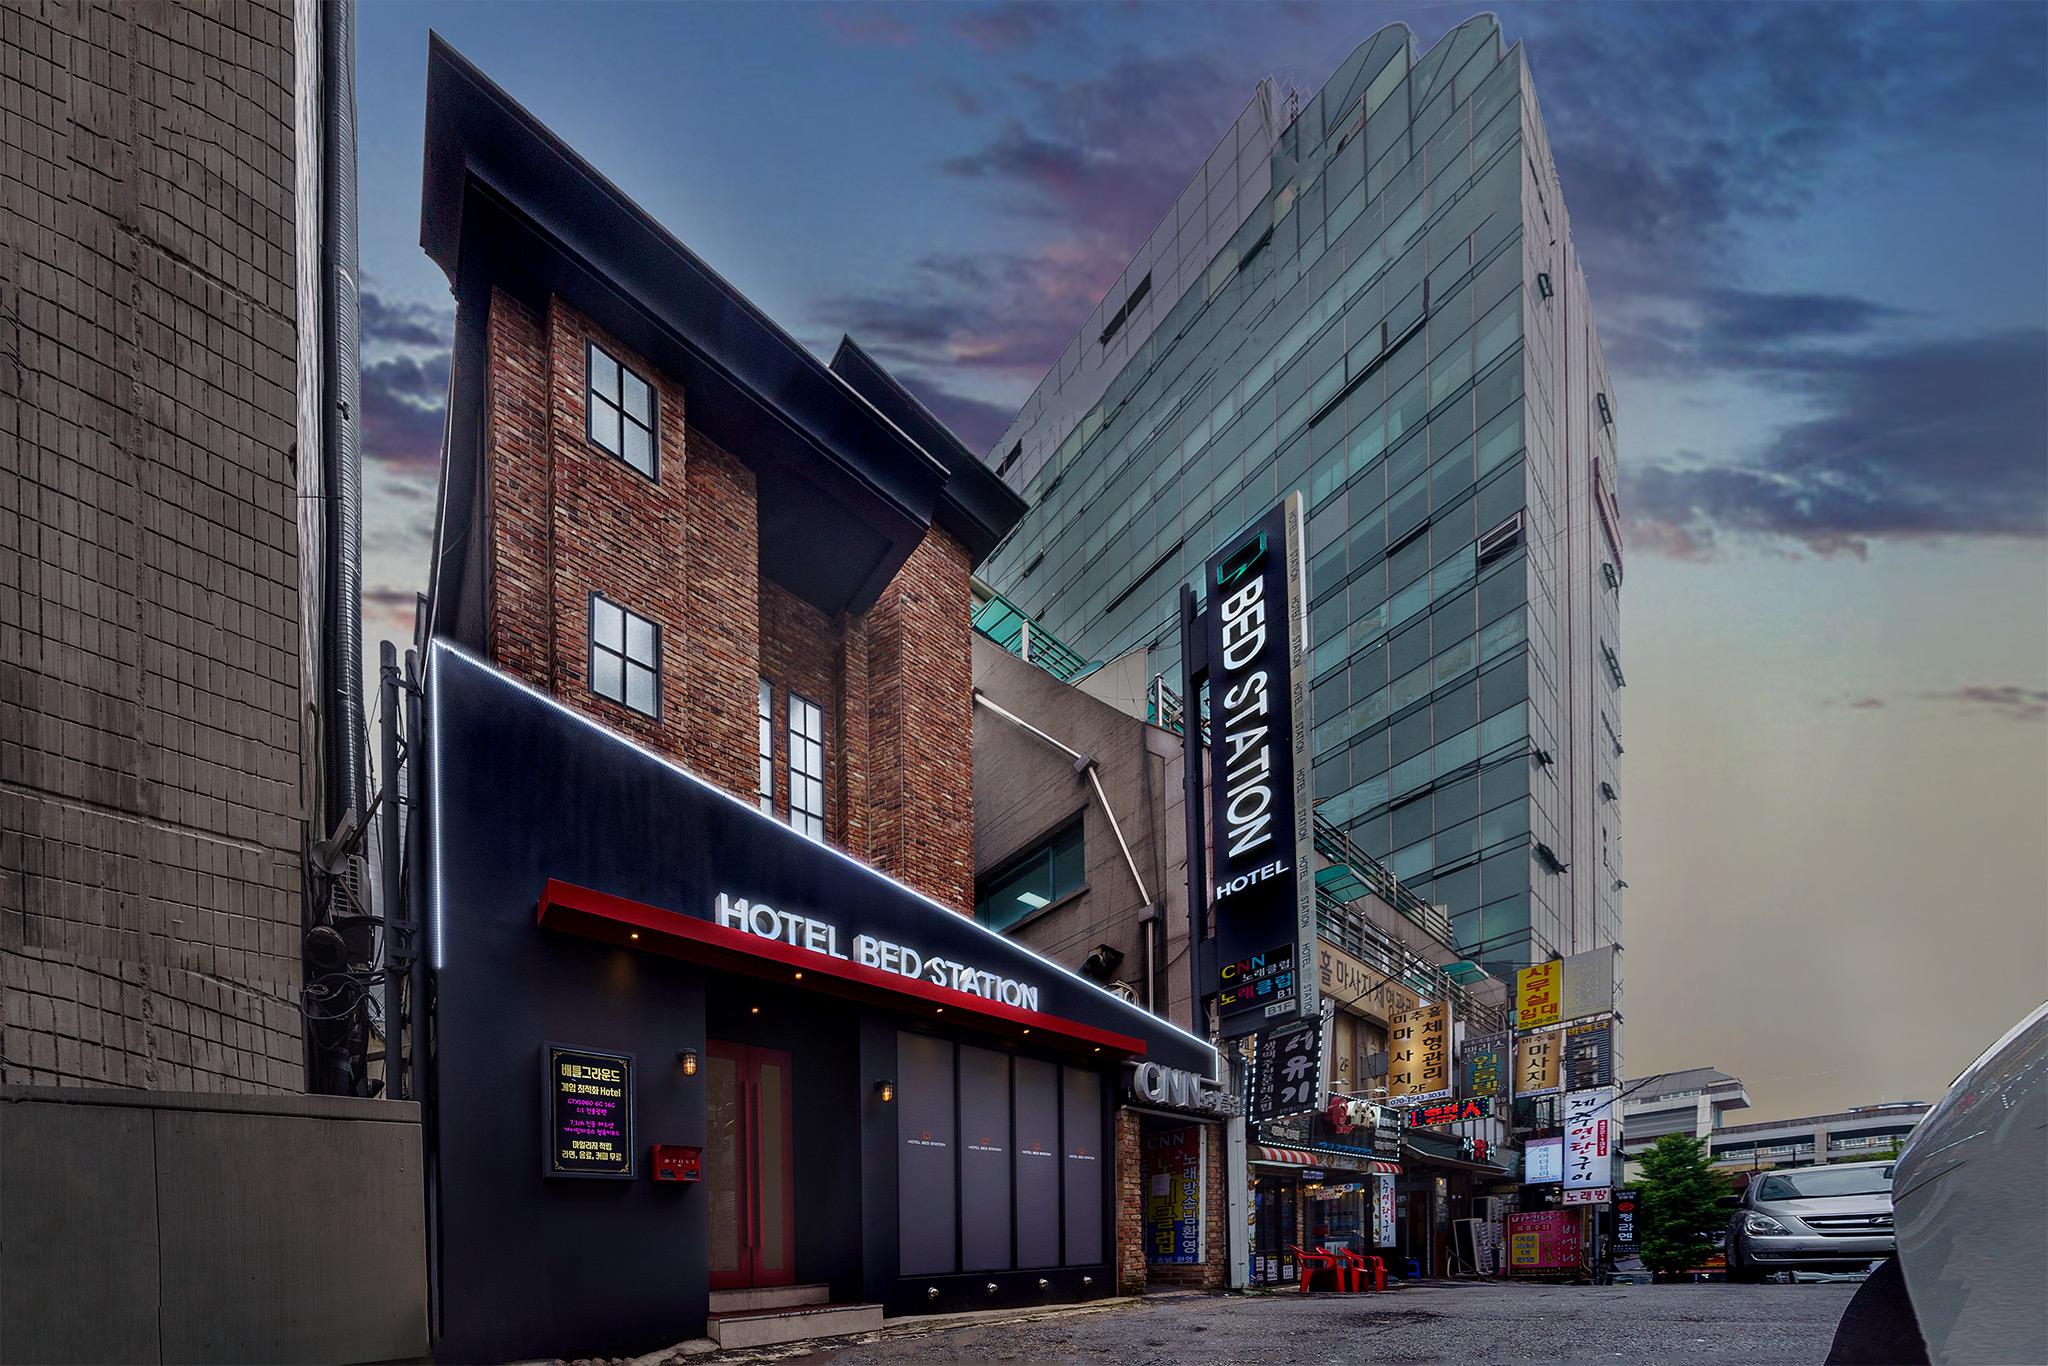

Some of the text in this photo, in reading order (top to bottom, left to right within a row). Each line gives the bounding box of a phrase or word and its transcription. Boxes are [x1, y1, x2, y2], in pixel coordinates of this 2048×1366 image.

[1293, 634, 1302, 668] STATION
[1294, 681, 1303, 707] HOTEL
[1221, 575, 1273, 858] BED STATION
[1295, 721, 1304, 754] STATION
[1297, 768, 1306, 794] HOTEL
[1298, 808, 1307, 841] STATION
[1217, 860, 1290, 900] HOTEL
[1299, 855, 1308, 880] HOTEL
[1300, 895, 1310, 928] STATION
[715, 892, 1038, 1012] HOTEL BED STATION
[1221, 953, 1265, 979] CNN
[1302, 943, 1311, 968] HOTEL
[1242, 959, 1290, 982] 노래클럽
[1336, 959, 1372, 1002] 마사지
[1526, 964, 1552, 1007] 사무실
[1220, 971, 1291, 1006] 노래클럽
[1277, 988, 1292, 999] B1
[1303, 984, 1312, 1016] STATION
[1268, 1001, 1291, 1016] B1F
[1394, 1005, 1442, 1024] 미추홀
[1520, 1003, 1558, 1021] 임대
[1392, 1028, 1415, 1085] 마사지
[1422, 1019, 1446, 1079] 체형관리
[1526, 1043, 1550, 1082] 마사지
[561, 1064, 620, 1082] 배틀그라운드
[1134, 1061, 1200, 1109] CNN
[1410, 1083, 1426, 1094] 2F
[577, 1085, 599, 1096] 최적화
[600, 1087, 621, 1097] Hotel
[1147, 1134, 1185, 1150] CNN
[1569, 1098, 1596, 1181] 제주연탄구이
[1566, 1190, 1608, 1202] 노래방
